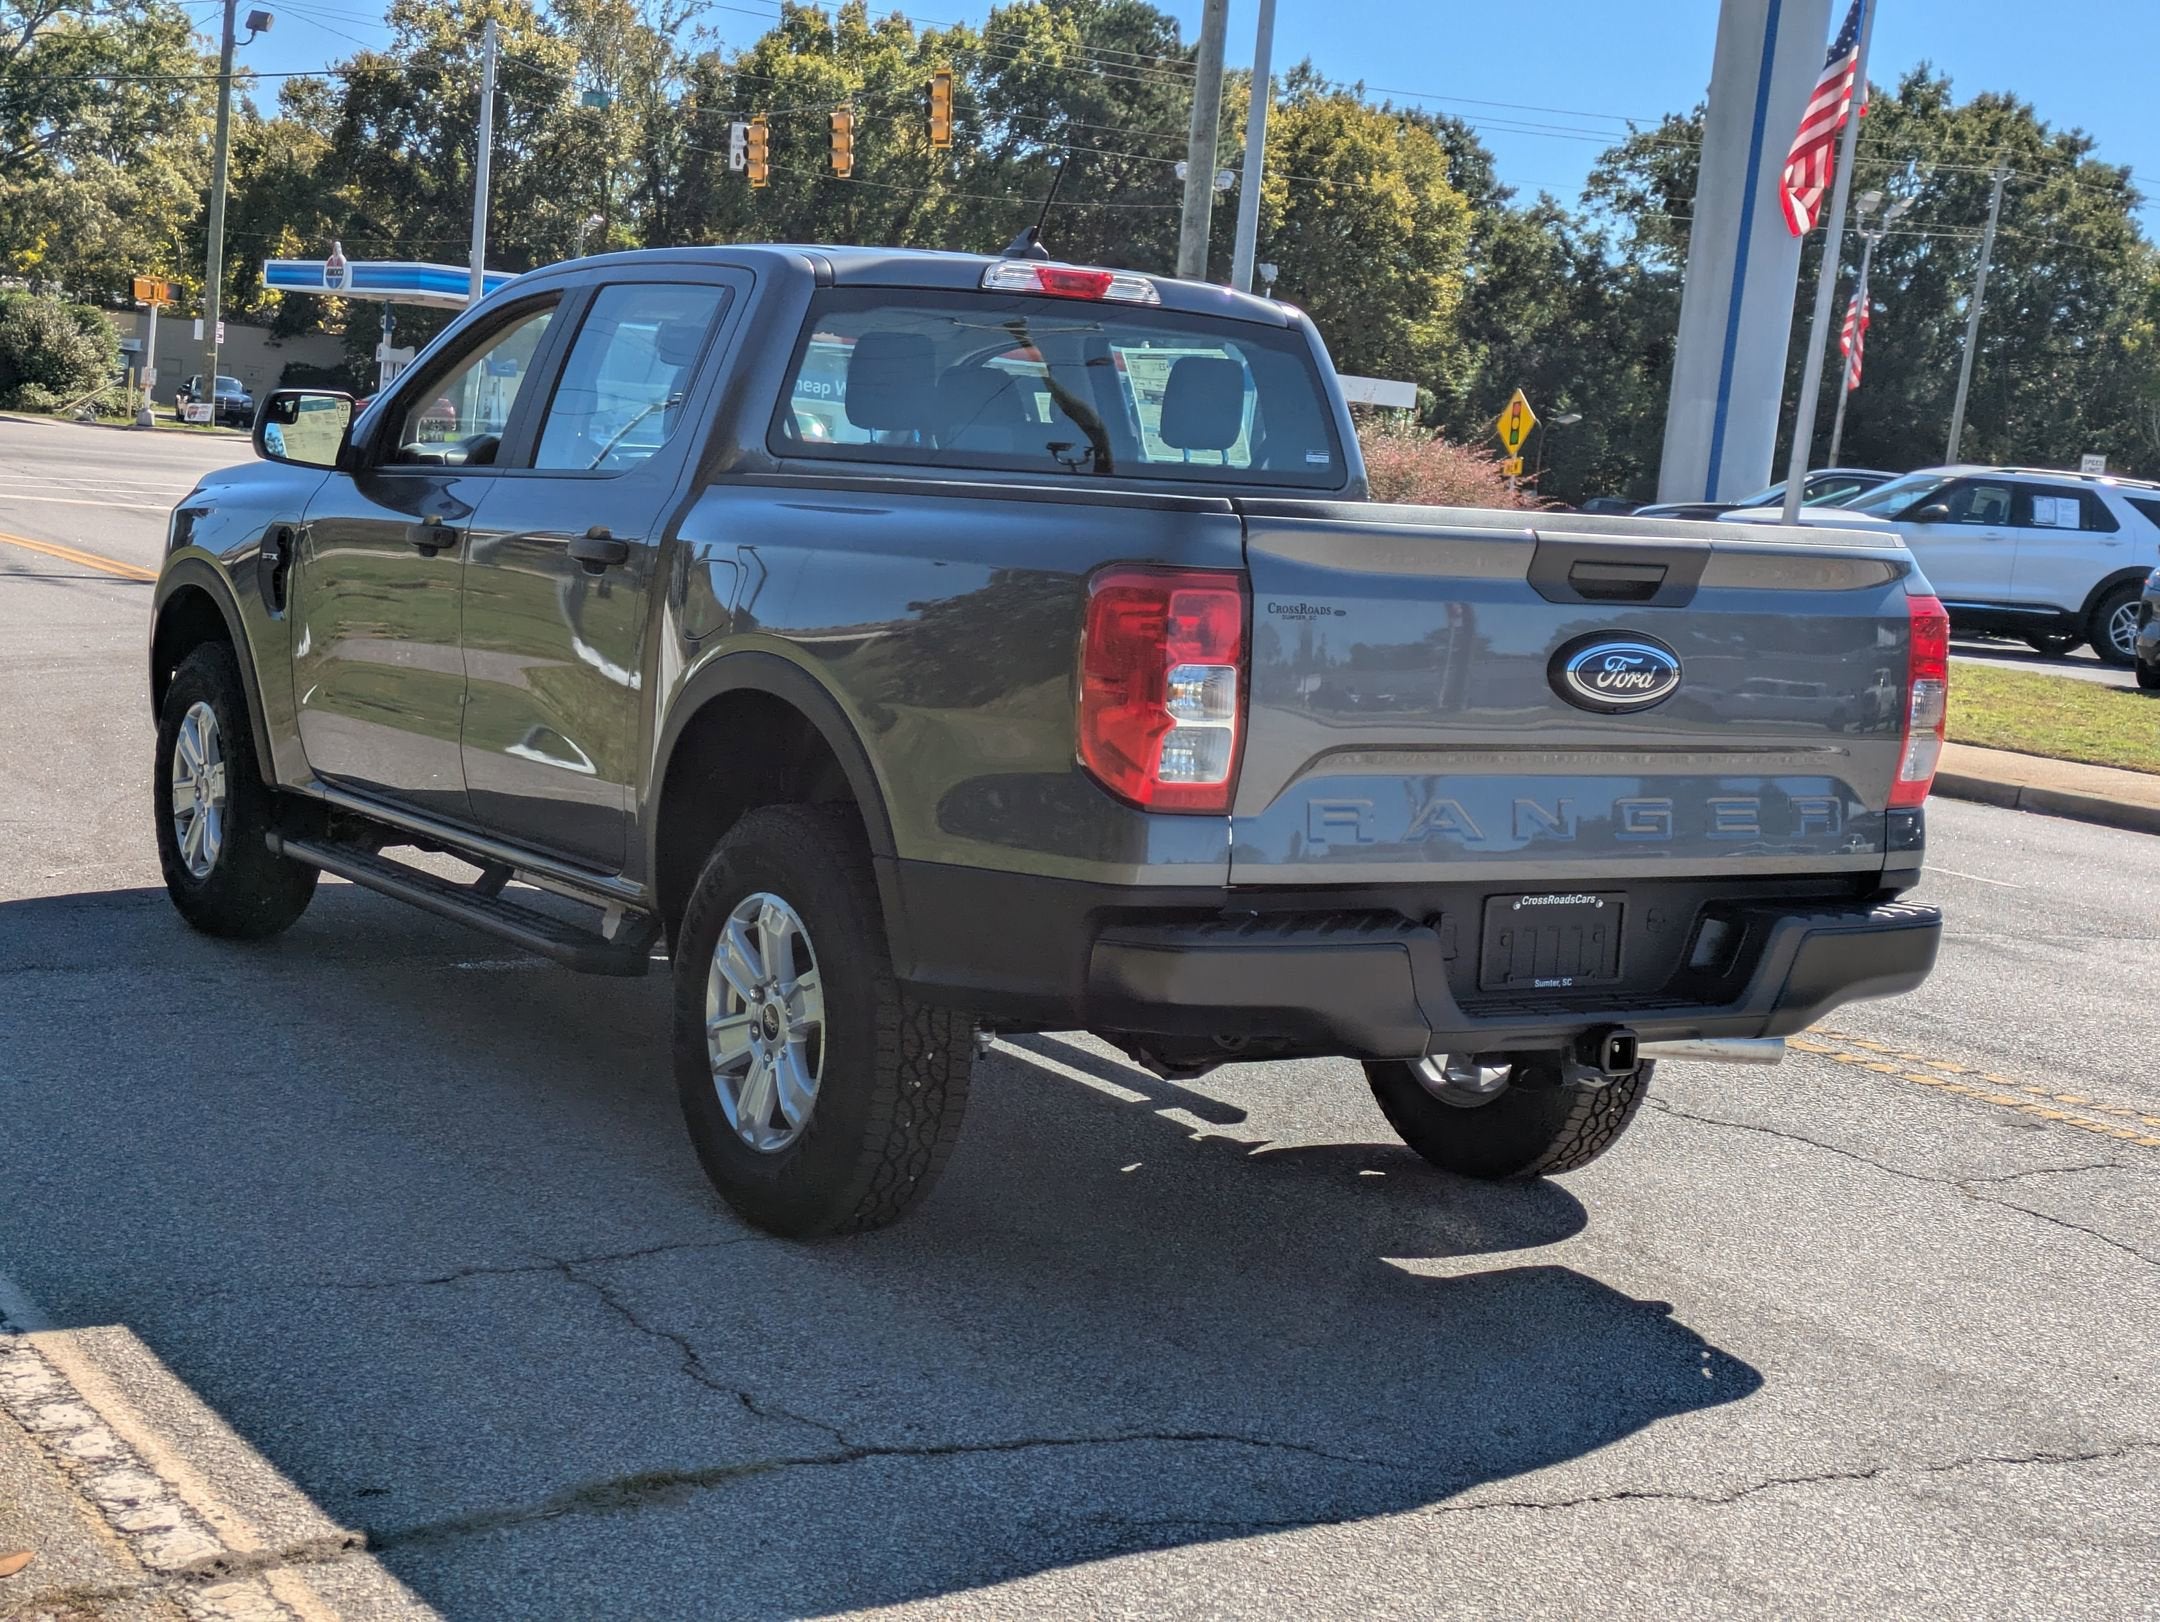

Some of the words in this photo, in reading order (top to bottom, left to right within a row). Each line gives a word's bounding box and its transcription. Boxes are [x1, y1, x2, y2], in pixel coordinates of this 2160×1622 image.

[2084, 459, 2104, 467] SPEED
[1596, 655, 1659, 689] Ford
[1307, 798, 1843, 843] RANGER
[1521, 894, 1597, 906] CrossRoadsCars
[1534, 979, 1561, 988] Sumter,
[1562, 977, 1573, 987] SC
